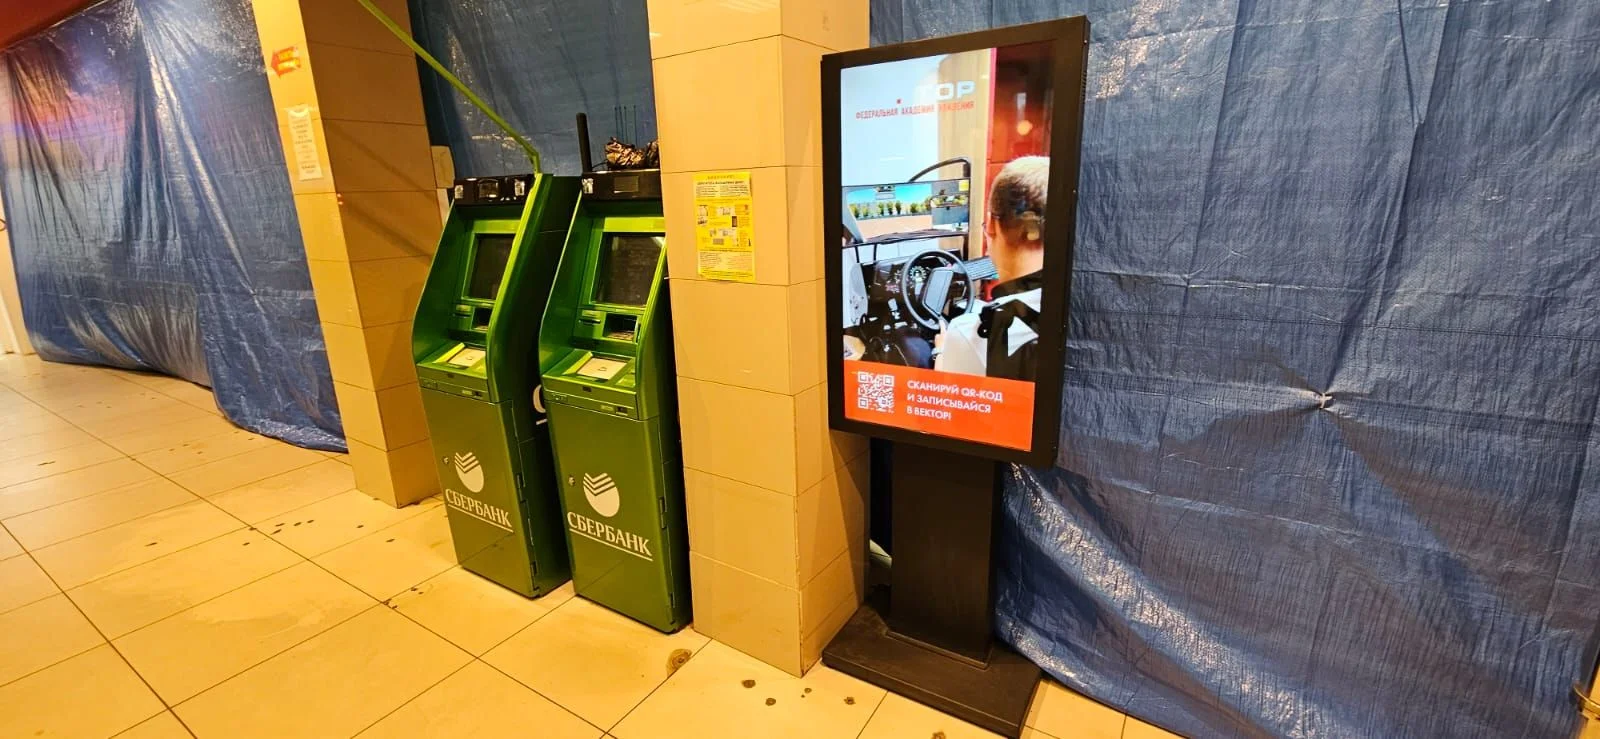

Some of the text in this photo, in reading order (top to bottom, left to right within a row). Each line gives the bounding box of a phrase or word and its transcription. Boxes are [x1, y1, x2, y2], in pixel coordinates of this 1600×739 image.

[856, 107, 899, 120] ФЕДЕРАЛЬНАЯ
[907, 380, 1003, 403] СКАНИРУЙ QR-КОД
[906, 406, 952, 420] В ВЕКТОР!
[907, 393, 991, 413] И ЗАПИСЫВАЙСЯ
[445, 488, 513, 528] СБЕРБАНК
[567, 511, 653, 557] СБЕРБАНК
